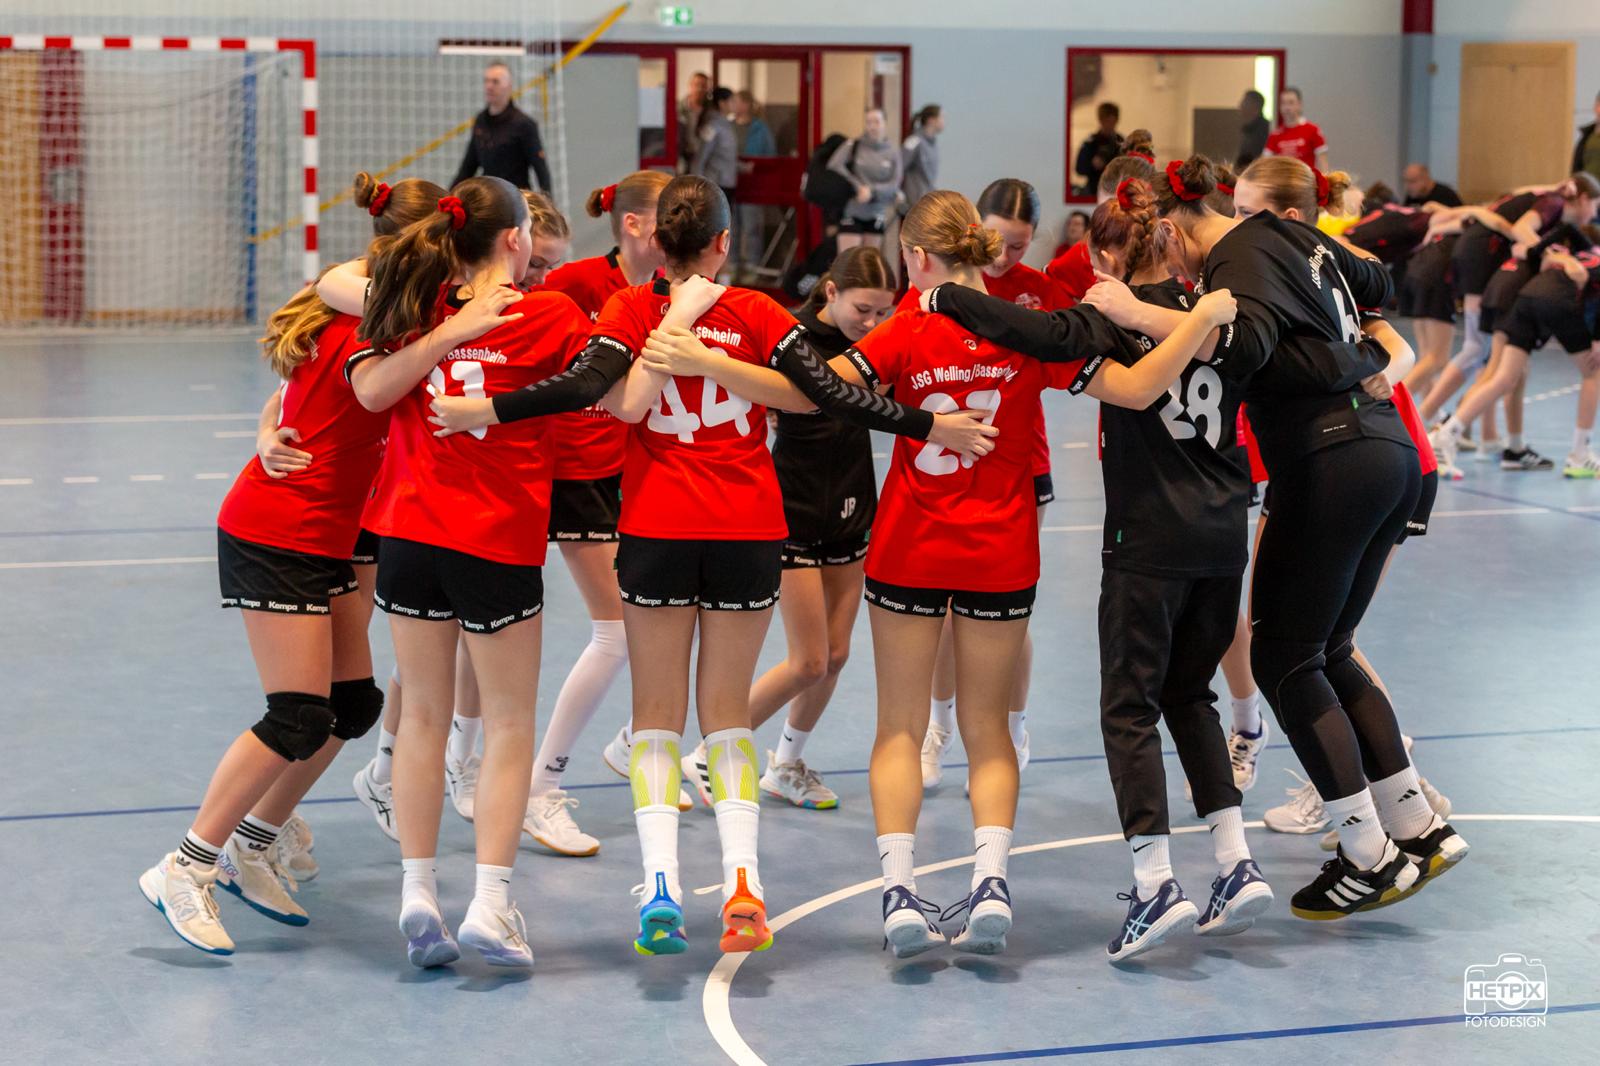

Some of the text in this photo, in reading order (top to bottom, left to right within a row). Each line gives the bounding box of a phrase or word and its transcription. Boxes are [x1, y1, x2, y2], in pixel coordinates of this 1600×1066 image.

[598, 336, 627, 352] Kempa
[777, 329, 799, 351] Kempa
[852, 351, 872, 376] Kempa
[911, 371, 932, 390] JSG
[268, 601, 298, 612] Kempa
[635, 594, 662, 607] Kempa
[718, 601, 742, 610] Kempa
[748, 597, 773, 609] Kempa
[880, 596, 906, 610] Kempa
[391, 603, 420, 616] Kempa
[974, 609, 1001, 618] Kempa
[490, 615, 515, 629] Kempa
